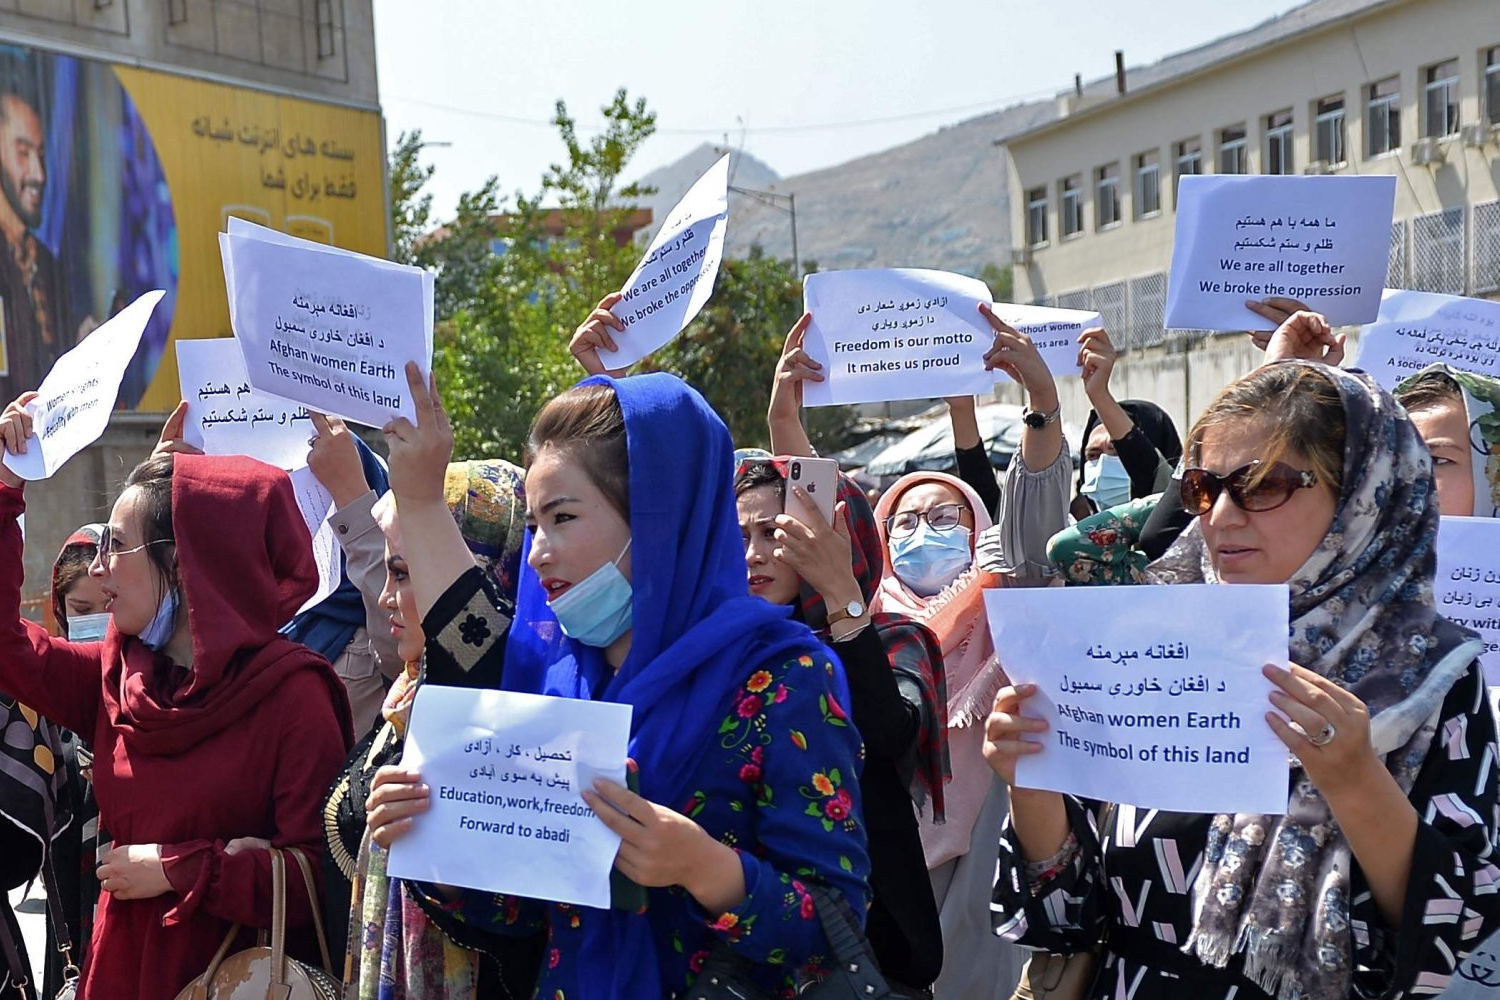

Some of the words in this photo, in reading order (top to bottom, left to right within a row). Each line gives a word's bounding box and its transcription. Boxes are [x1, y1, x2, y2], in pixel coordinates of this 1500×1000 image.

[1235, 215, 1266, 231] هستیم
[1270, 217, 1283, 231] هم
[1288, 216, 1297, 230] با
[1300, 218, 1320, 227] همه
[1325, 217, 1336, 227] ما
[1234, 236, 1276, 252] شکستیم
[1278, 238, 1300, 253] ستم
[1302, 242, 1311, 252] و
[1313, 238, 1333, 254] ظلم
[622, 286, 640, 302] We
[641, 278, 659, 293] are
[659, 267, 672, 283] all
[671, 246, 707, 275] together
[1219, 258, 1242, 271] We
[1244, 261, 1265, 272] are
[1268, 260, 1284, 272] all
[1287, 261, 1345, 276] together
[1199, 281, 1221, 293] We
[1223, 281, 1261, 294] broke
[1264, 282, 1285, 295] the
[1288, 284, 1362, 299] oppression
[635, 299, 664, 320] broke
[664, 290, 679, 304] the
[874, 300, 895, 313] شعار
[275, 315, 306, 333] سمبول
[926, 315, 935, 324] دا
[1018, 324, 1047, 334] ithout
[1049, 322, 1082, 332] women
[346, 332, 374, 348] افغان
[378, 338, 385, 349] د
[834, 339, 890, 353] Freedom
[894, 337, 904, 349] is
[907, 335, 930, 348] our
[933, 332, 973, 345] motto
[1049, 339, 1069, 348] area
[269, 339, 309, 361] Afghan
[310, 352, 356, 373] women
[359, 360, 396, 380] Earth
[847, 363, 857, 374] It
[860, 359, 901, 373] makes
[904, 359, 919, 370] us
[922, 353, 960, 371] proud
[1387, 357, 1395, 366] A
[1397, 360, 1429, 370] societ
[198, 382, 231, 402] هستیم
[236, 382, 251, 400] هم
[267, 360, 290, 378] The
[291, 369, 332, 391] symbol
[334, 382, 346, 395] of
[347, 385, 370, 402] this
[372, 390, 401, 409] land
[201, 407, 248, 430] شکستیم
[251, 408, 274, 429] ستم
[277, 411, 287, 425] و
[1451, 567, 1480, 582] زنان
[1443, 591, 1473, 606] زبان
[1059, 674, 1103, 694] سمبول
[1168, 674, 1209, 697] افغان
[1217, 680, 1226, 693] د
[1057, 703, 1105, 725] Afghan
[1107, 714, 1180, 728] women
[1187, 711, 1241, 729] Earth
[464, 738, 492, 756] آزادی
[505, 743, 521, 759] کار
[534, 746, 572, 762] تحصیل
[1057, 730, 1081, 750] The
[1083, 740, 1134, 759] symbol
[1138, 745, 1159, 762] of
[1163, 745, 1200, 763] this
[1205, 746, 1251, 764] land
[500, 772, 528, 784] سوی
[530, 772, 543, 786] به
[546, 772, 570, 792] پیش
[459, 815, 516, 836] Forward
[518, 825, 532, 838] to
[535, 826, 570, 843] abadi
